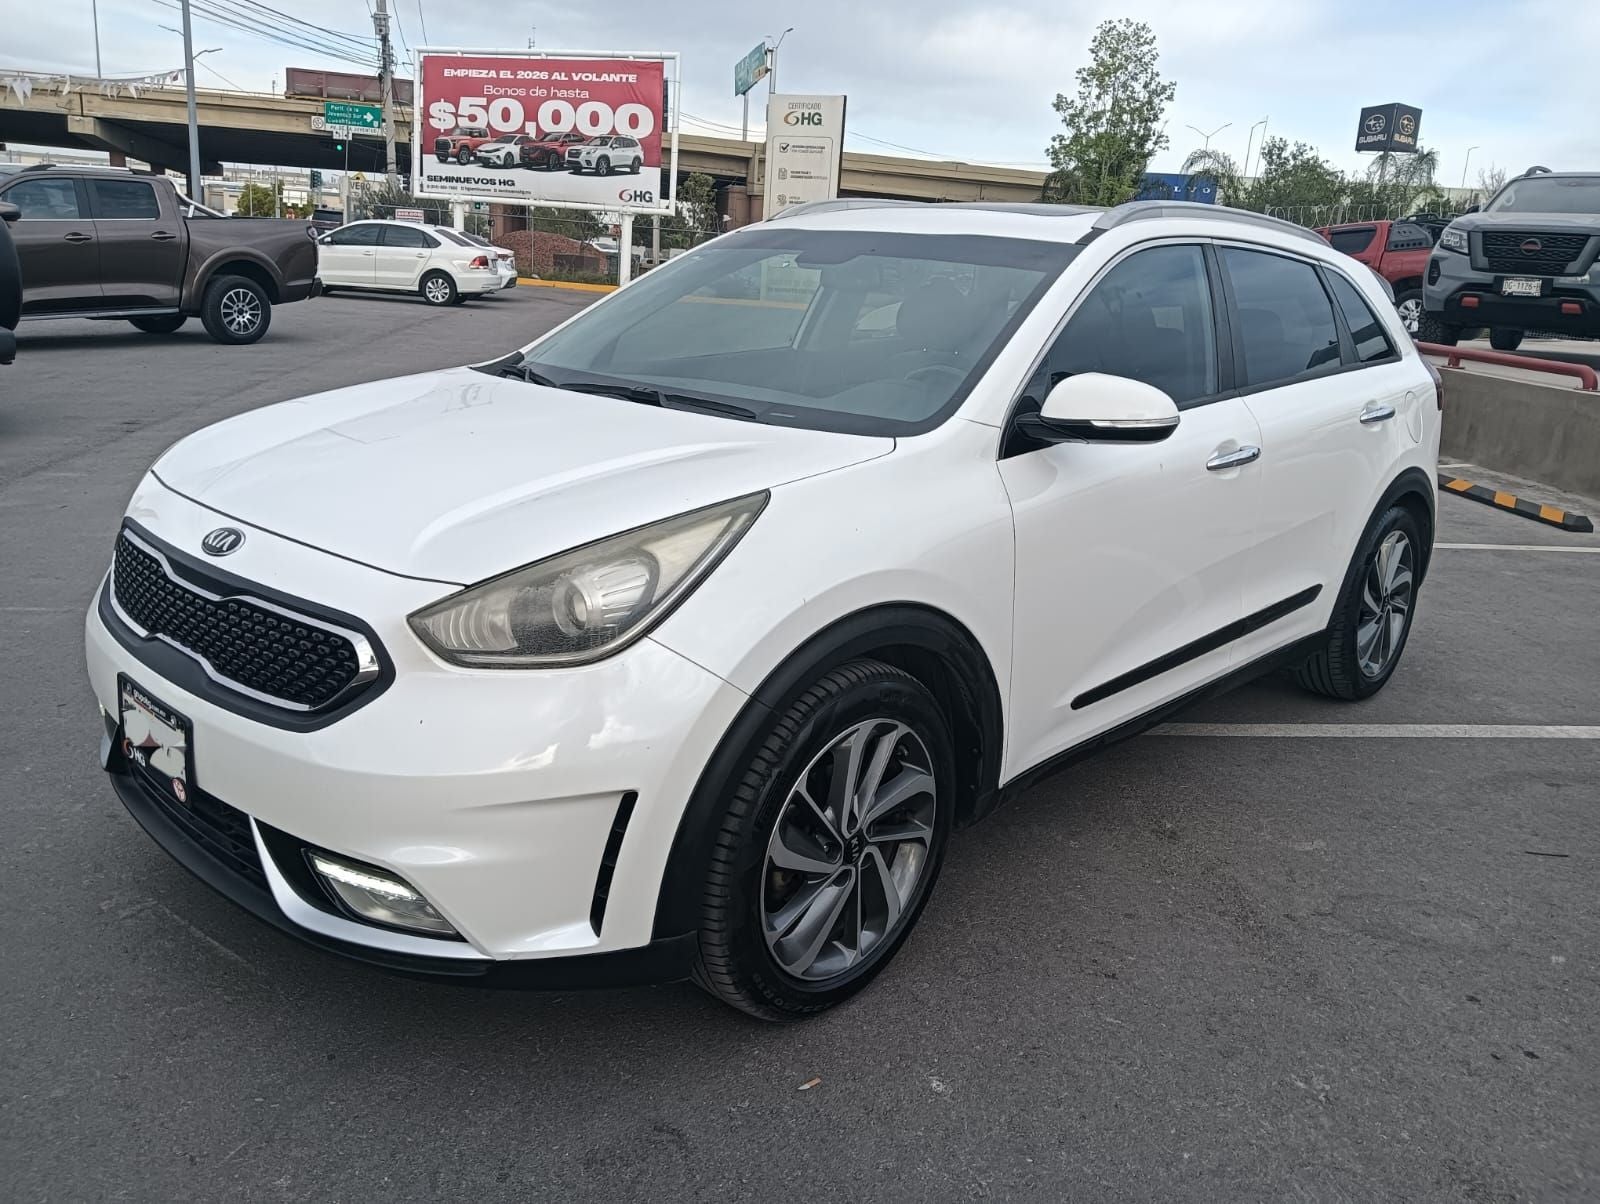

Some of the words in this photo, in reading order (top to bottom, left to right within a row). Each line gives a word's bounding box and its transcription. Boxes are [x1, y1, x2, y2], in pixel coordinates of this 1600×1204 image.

[443, 68, 497, 78] EMPIEZA
[499, 70, 515, 79] EL
[516, 70, 549, 80] 2026
[551, 71, 569, 81] AL
[571, 72, 638, 83] VOLANTE
[483, 84, 527, 96] Bonos
[529, 85, 548, 97] de
[550, 86, 590, 99] hasta
[787, 102, 822, 111] CERTIFICADO
[428, 96, 655, 140] $50,000
[426, 175, 497, 186] SEMINUEVOS
[498, 179, 516, 187] HG
[204, 530, 238, 552] KIA
